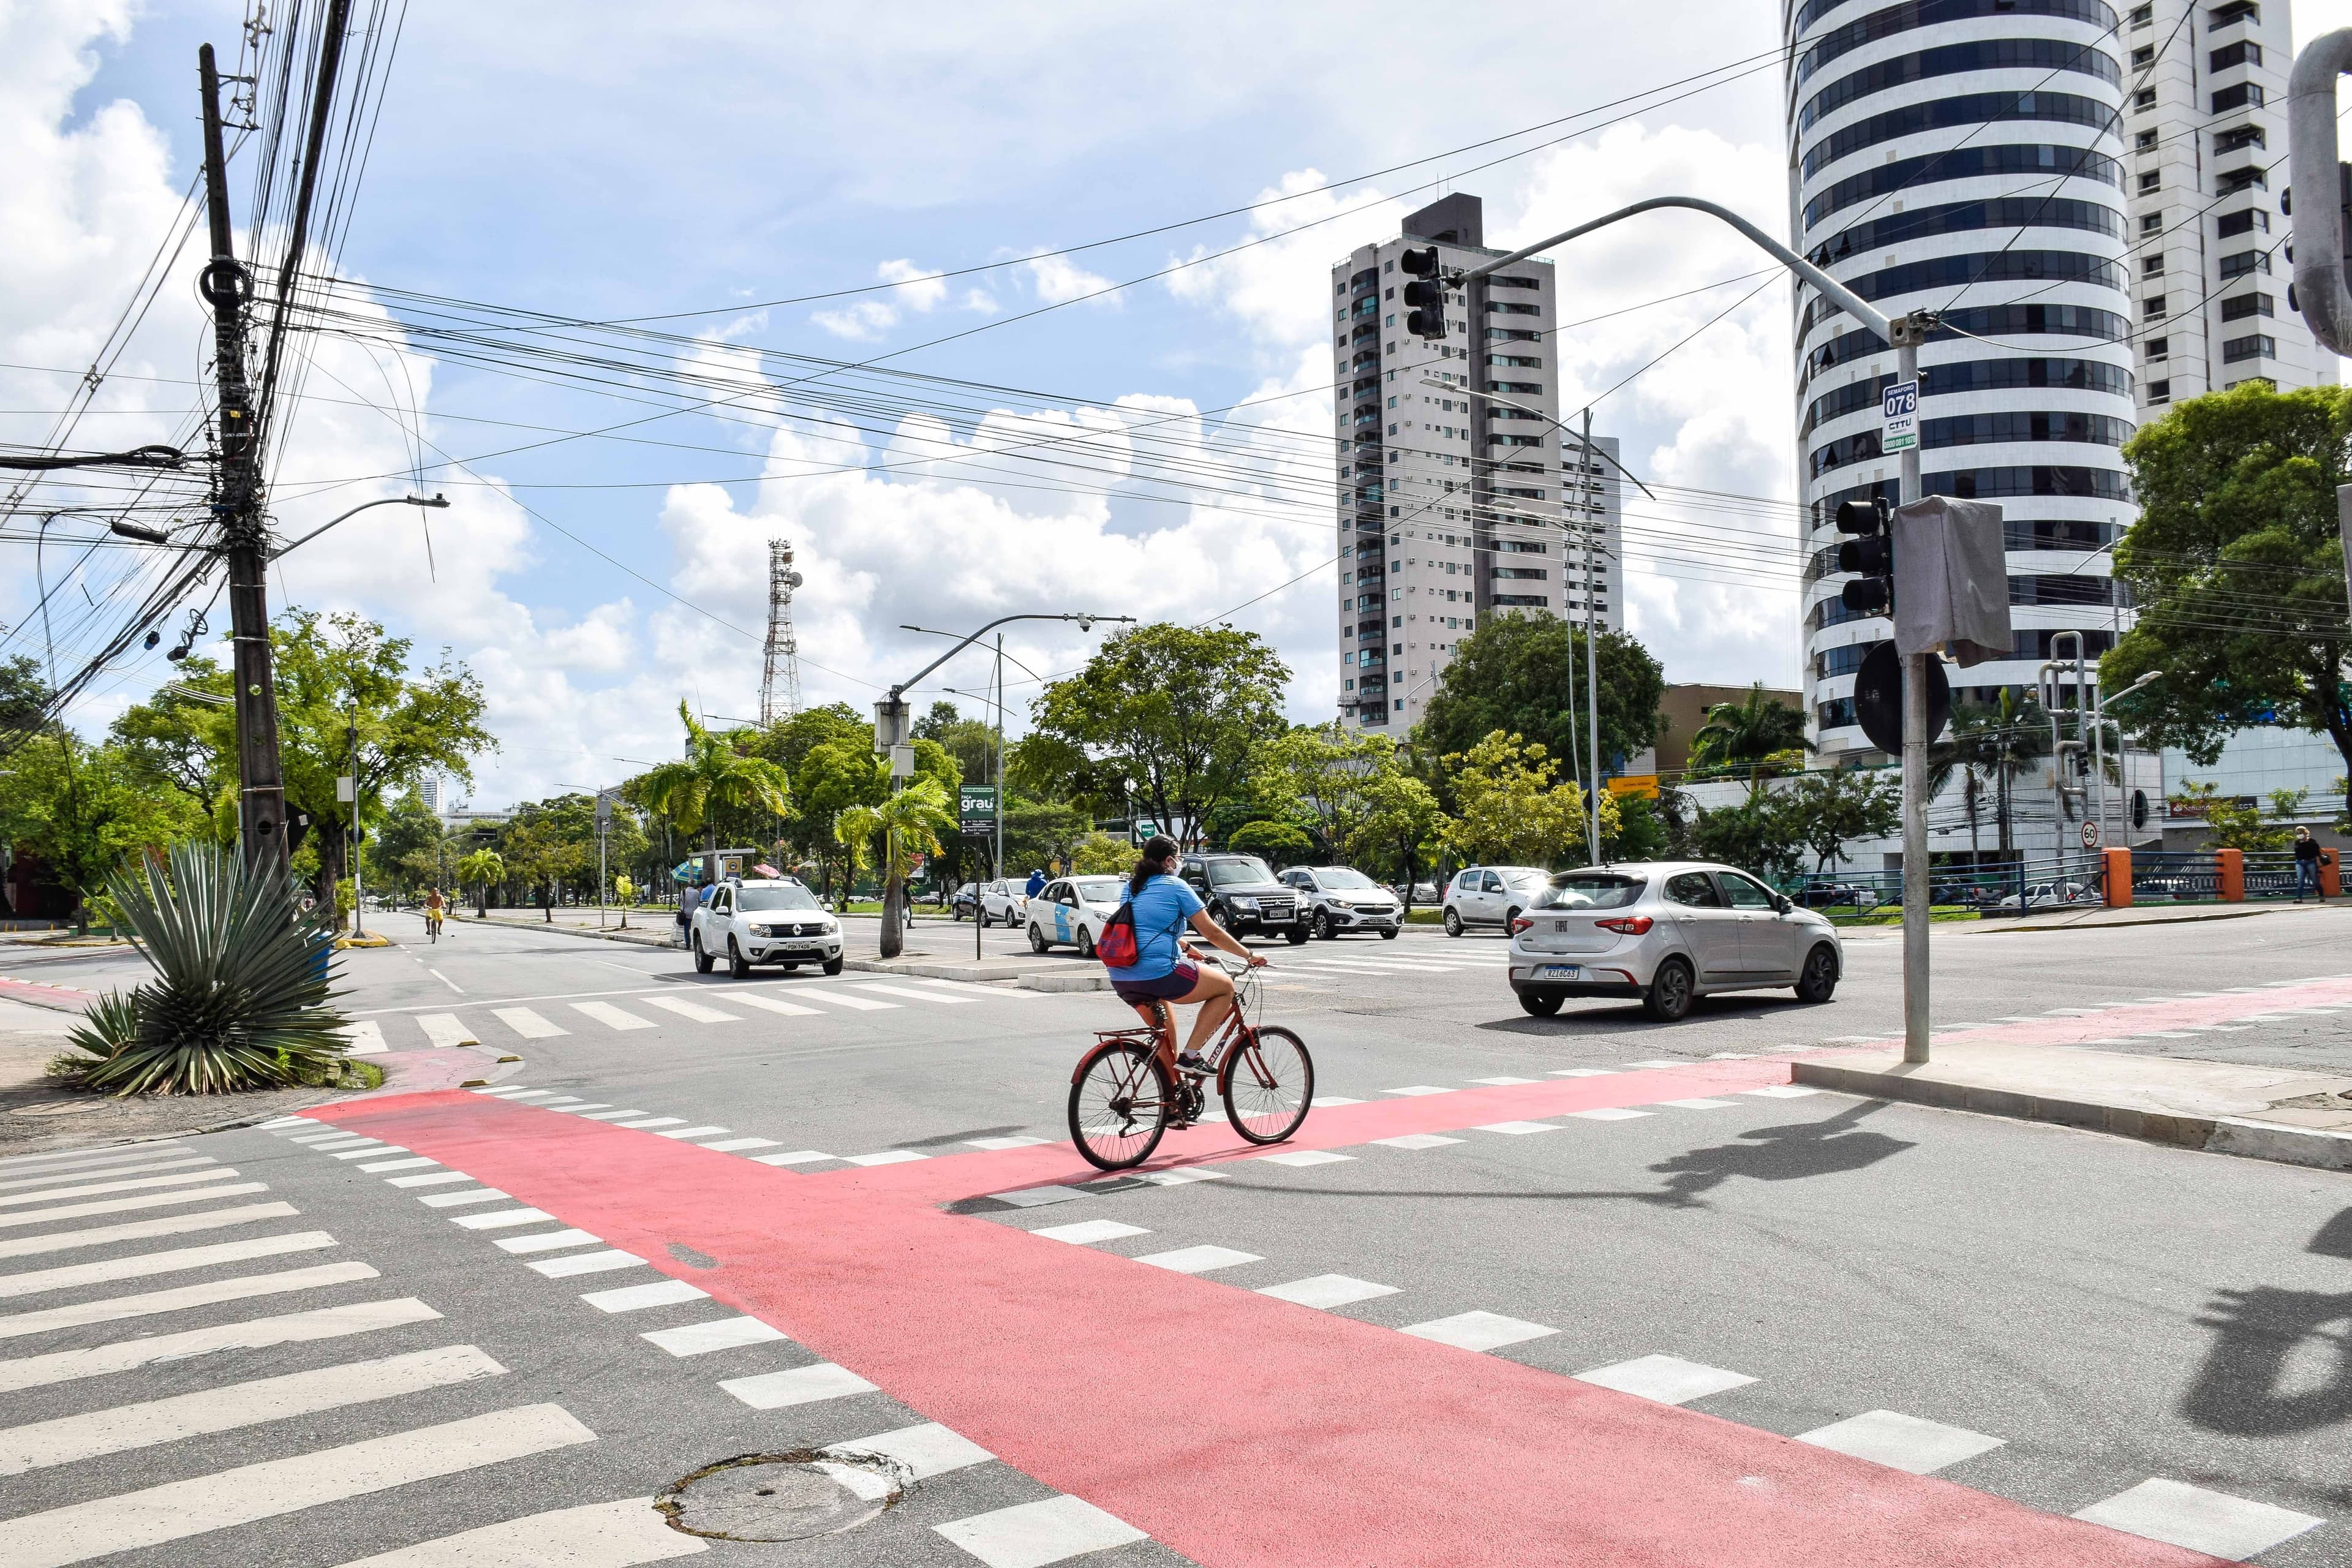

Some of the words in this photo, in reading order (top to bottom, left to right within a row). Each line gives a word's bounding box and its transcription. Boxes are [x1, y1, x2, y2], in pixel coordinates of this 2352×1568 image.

[1888, 385, 1914, 396] SEMÁFORO
[1887, 393, 1915, 415] 078
[1889, 418, 1911, 429] CTTU
[961, 799, 993, 812] grau
[2084, 828, 2095, 839] 60
[1556, 921, 1567, 932] FIAT
[1208, 1046, 1221, 1066] CALOI
